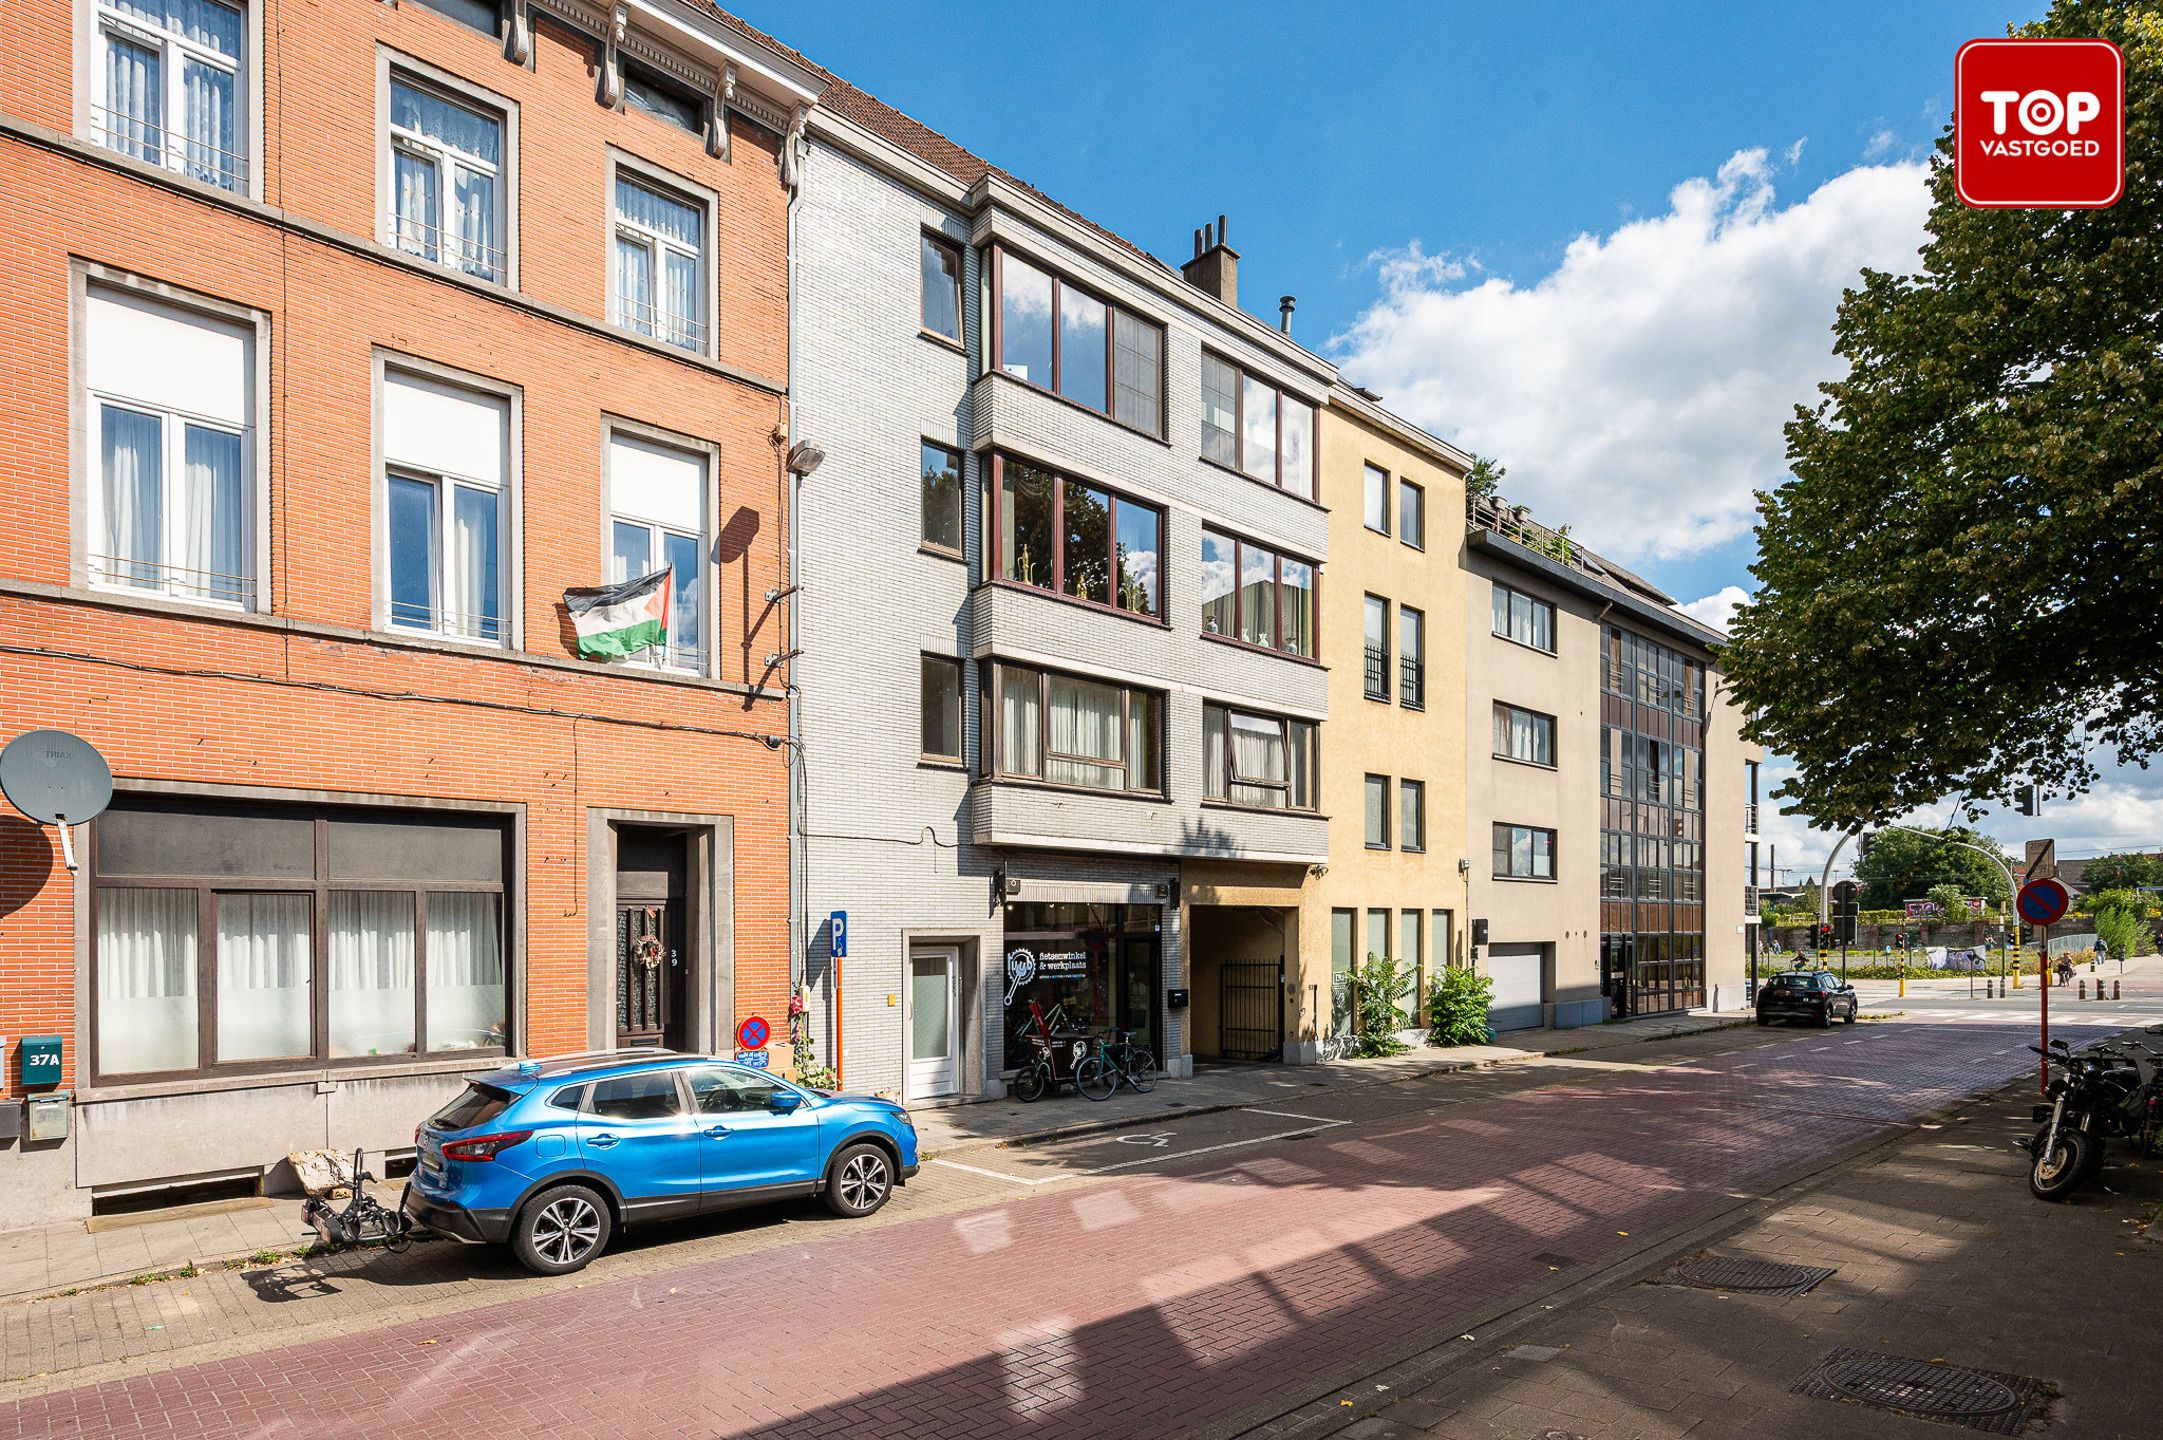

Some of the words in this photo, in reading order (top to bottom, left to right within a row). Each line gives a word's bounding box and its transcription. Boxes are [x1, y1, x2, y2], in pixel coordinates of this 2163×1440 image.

[832, 918, 844, 950] P
[1039, 962, 1046, 970] &
[1047, 961, 1087, 970] werkplaats
[29, 1054, 60, 1066] 37A
